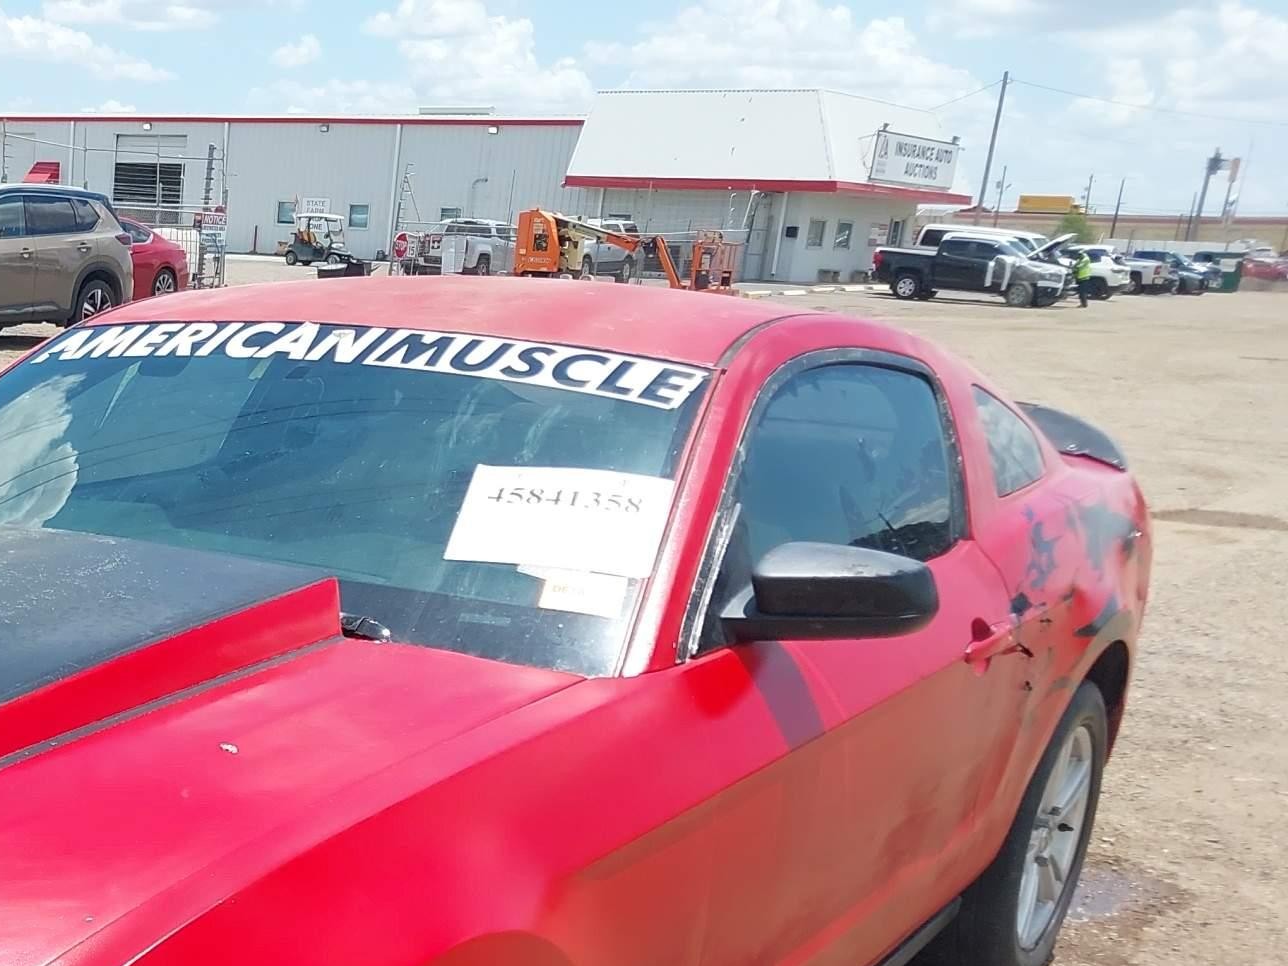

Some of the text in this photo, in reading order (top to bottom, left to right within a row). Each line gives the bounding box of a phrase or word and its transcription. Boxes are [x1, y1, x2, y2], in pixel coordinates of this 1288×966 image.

[895, 141, 934, 161] INSURANCE
[935, 147, 953, 164] AUTO
[904, 162, 938, 180] AUCTIONS
[202, 215, 227, 225] NOTICE
[395, 240, 408, 250] STOP
[487, 487, 643, 513] 45841358
